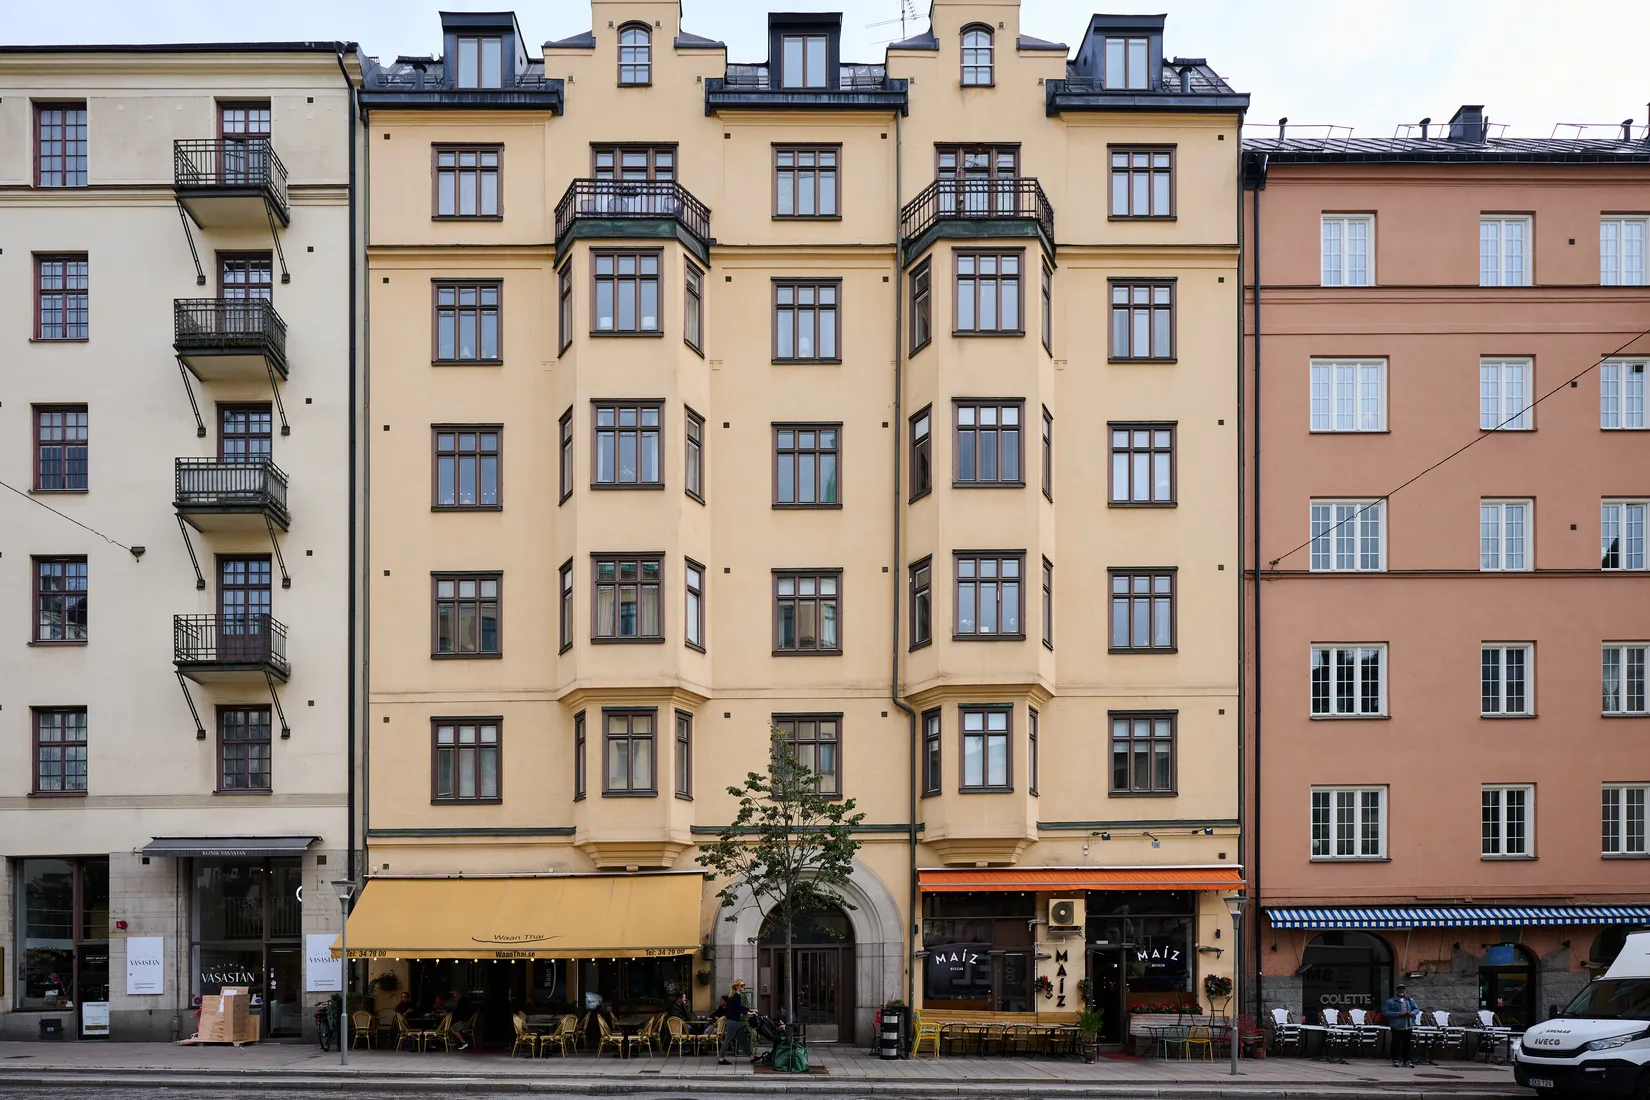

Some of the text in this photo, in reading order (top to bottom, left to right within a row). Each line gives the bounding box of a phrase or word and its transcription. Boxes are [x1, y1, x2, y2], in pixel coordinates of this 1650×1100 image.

[935, 948, 978, 965] MAÍZ
[1137, 945, 1180, 961] MAÍZ
[201, 972, 255, 983] VASASTAN
[1055, 949, 1068, 1007] MAÍZ
[1319, 993, 1372, 1005] COLETTE
[1534, 1038, 1560, 1046] IVECO
